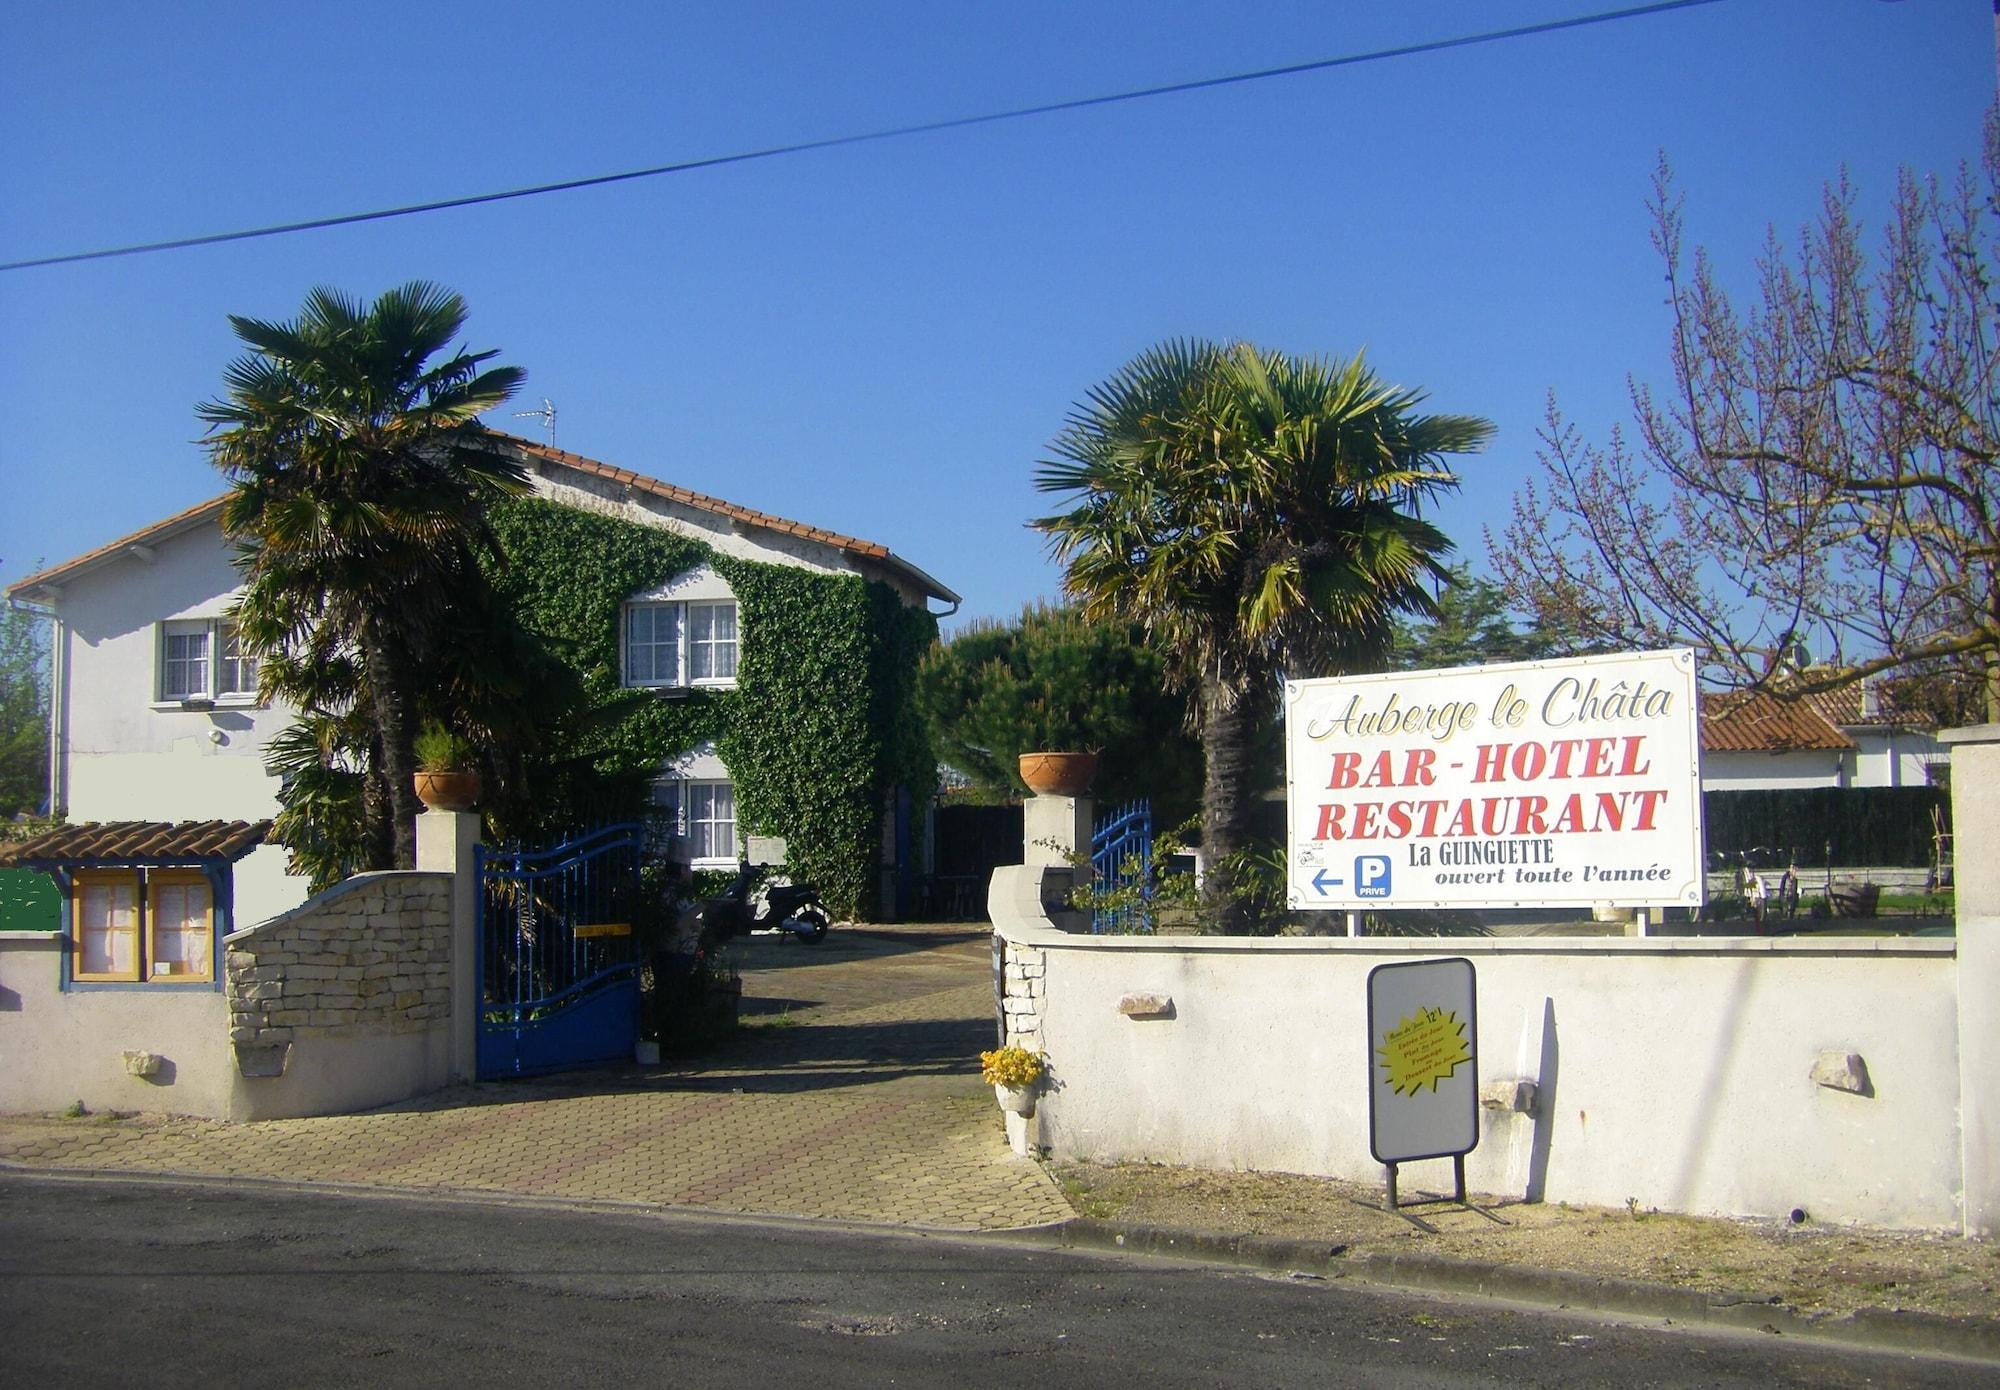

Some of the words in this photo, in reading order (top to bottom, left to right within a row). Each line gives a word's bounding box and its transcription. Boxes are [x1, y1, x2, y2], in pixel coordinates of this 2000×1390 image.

[1307, 692, 1477, 742] Auberge
[1488, 683, 1528, 728] le
[1541, 677, 1673, 728] Châta
[1325, 748, 1437, 790] BAR
[1470, 735, 1651, 784] HOTEL
[1312, 790, 1668, 841] RESTAURANT
[1408, 843, 1431, 867] La
[1439, 839, 1554, 866] GUINGUETTE
[1361, 858, 1386, 887] P
[1435, 867, 1506, 885] ouvert
[1515, 867, 1573, 884] toute
[1583, 863, 1672, 883] l'année
[1359, 887, 1386, 896] PRIVE
